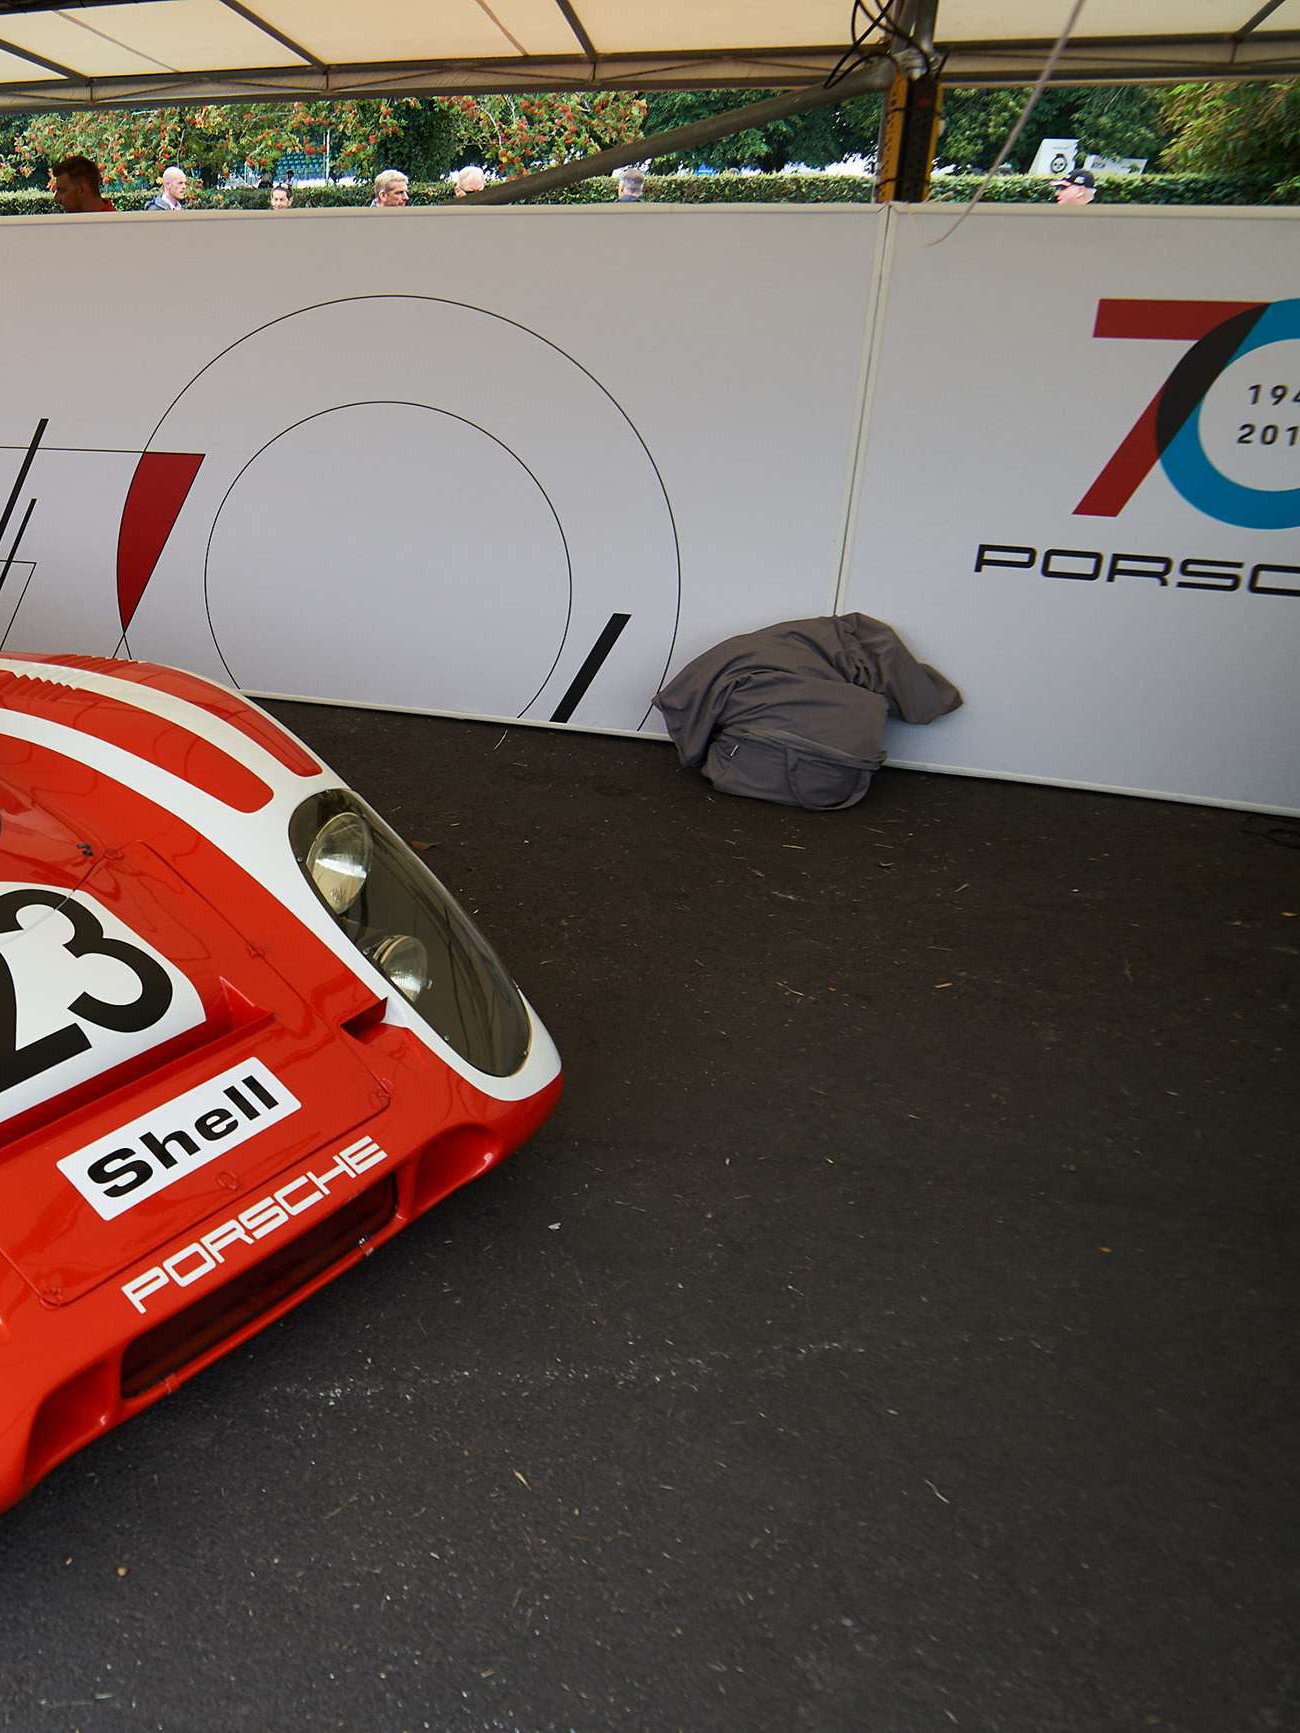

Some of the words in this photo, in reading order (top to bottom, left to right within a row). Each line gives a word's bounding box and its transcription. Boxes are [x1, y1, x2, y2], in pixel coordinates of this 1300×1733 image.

[1236, 423, 1300, 447] 201
[973, 543, 1300, 598] PORSC
[86, 1074, 280, 1200] Shell
[120, 1135, 388, 1314] PORSCHE
